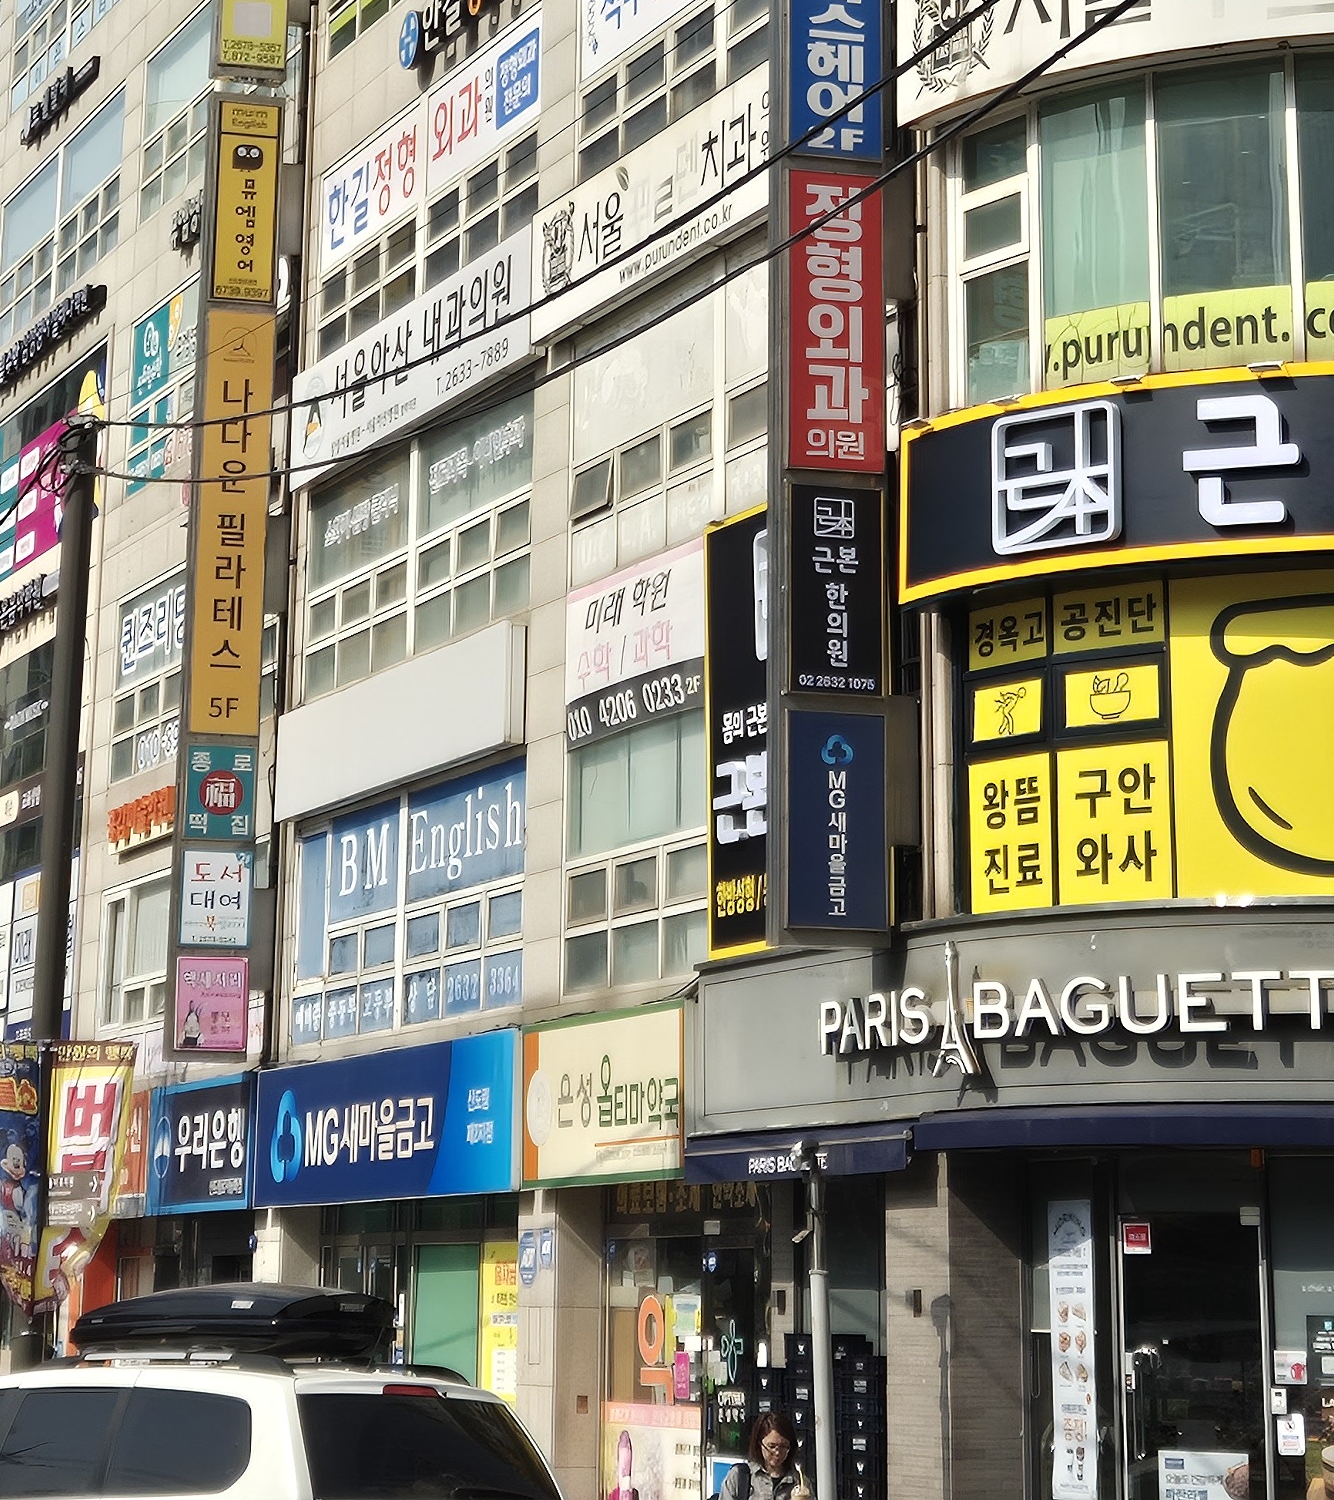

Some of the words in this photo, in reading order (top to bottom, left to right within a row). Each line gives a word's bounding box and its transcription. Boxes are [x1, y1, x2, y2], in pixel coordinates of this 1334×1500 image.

[810, 125, 864, 151] 2F
[805, 184, 869, 424] 정형외과
[219, 378, 253, 494] 나다운
[805, 428, 866, 460] 의원
[812, 547, 858, 574] 근본
[210, 514, 247, 670] 필라테스
[585, 586, 623, 633] 미래
[631, 569, 671, 616] 학원
[1059, 591, 1158, 638] 공진단
[825, 583, 848, 667] 한의원
[974, 607, 1044, 657] 경옥고
[578, 646, 610, 690] 수학
[208, 697, 239, 718] 5F
[567, 705, 590, 741] 010
[599, 691, 637, 726] 4206
[642, 675, 684, 712] 0233
[192, 752, 252, 772] 종로
[206, 778, 235, 807] 福
[981, 780, 1042, 833] 왕뜸
[1075, 766, 1153, 817] 구안
[189, 813, 249, 835] 떡집
[339, 824, 391, 895] BM
[407, 782, 523, 879] English
[828, 771, 847, 916] MG새마을금고
[191, 863, 243, 883] 도서
[984, 837, 1044, 893] 진료
[1075, 832, 1158, 882] 와사
[191, 890, 241, 910] 대여
[819, 986, 930, 1056] PARIS
[174, 1108, 245, 1172] 우리은행
[303, 1097, 434, 1168] MG새마을금고
